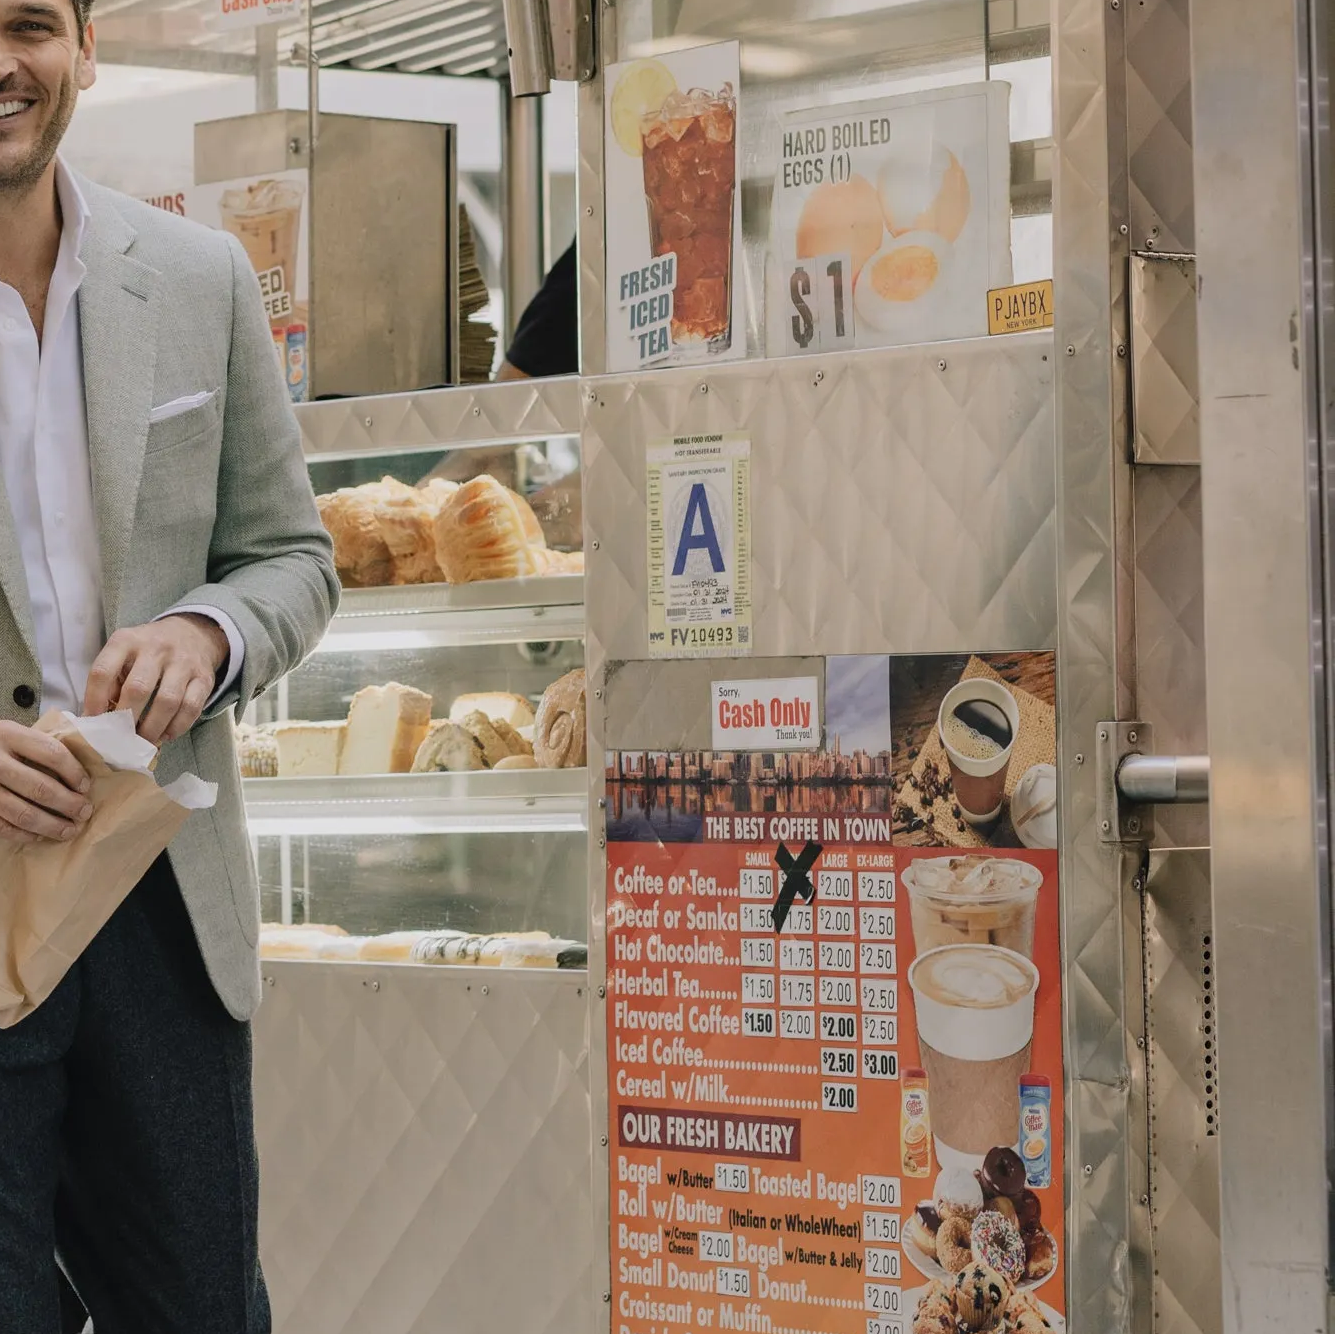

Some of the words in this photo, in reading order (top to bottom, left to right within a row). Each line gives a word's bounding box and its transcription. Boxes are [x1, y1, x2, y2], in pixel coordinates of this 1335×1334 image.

[783, 127, 826, 158] HARD
[832, 118, 891, 151] BOILED
[783, 158, 824, 188] EGGS
[830, 152, 851, 184] (1)
[620, 258, 673, 301] FRESH
[630, 293, 670, 331] ICED
[1007, 321, 1020, 329] NEW
[1022, 318, 1038, 327] YORK
[638, 326, 669, 360] TEA
[673, 436, 691, 446] MOBILE
[691, 435, 704, 444] FOOD
[704, 434, 723, 443] VENDOR
[671, 483, 726, 576] A
[650, 633, 664, 641] NYC
[718, 687, 740, 698] Sorry,
[719, 699, 765, 729] Cash
[770, 696, 811, 729] Only
[775, 729, 797, 740] Thank
[798, 728, 813, 741] you!
[706, 818, 730, 840] THE
[734, 817, 765, 840] BEST
[769, 818, 819, 841] COFFEE
[823, 818, 840, 841] IN
[844, 818, 891, 842] TOWN
[745, 852, 771, 866] SMALL
[822, 854, 848, 868] LARGE
[857, 854, 894, 868] EX-LARGE
[615, 867, 664, 895] Coffee
[668, 875, 686, 895] or
[743, 873, 772, 895] $1.50
[820, 874, 850, 898] $2.00
[862, 876, 893, 900] $2.50
[614, 900, 660, 929] Decaf
[664, 911, 682, 930] or
[687, 902, 738, 932] Sanka
[743, 907, 773, 929] $1.50
[819, 908, 851, 932] $2.00
[862, 911, 893, 936] $2.50
[615, 935, 641, 962] Hot
[743, 942, 773, 964] $1.50
[783, 946, 813, 968] $1.75
[821, 944, 851, 968] $2.00
[861, 945, 893, 970] $2.50
[615, 969, 668, 997] Herbal
[745, 977, 773, 999] $1.50
[782, 978, 813, 1003] $1.75
[822, 980, 852, 1003] $2.00
[863, 986, 895, 1010] $2.50
[615, 1002, 684, 1032] Flavored
[688, 1007, 740, 1036] Coffee
[745, 1012, 773, 1033] $1.50
[781, 1013, 811, 1035] $2.00
[823, 1016, 855, 1039] $2.00
[865, 1018, 895, 1041] $2.50
[616, 1036, 648, 1064] Iced
[823, 1051, 855, 1073] $2.50
[864, 1053, 897, 1076] $3.00
[616, 1069, 667, 1098] Cereal
[824, 1086, 855, 1108] $2.00
[622, 1112, 662, 1145] OUR
[666, 1115, 719, 1149] FRESH
[724, 1120, 795, 1155] BAKERY
[1025, 1114, 1042, 1126] Coffee
[618, 1155, 662, 1189] Bagel
[667, 1169, 714, 1190] w/Butter
[717, 1167, 747, 1189] $1.50
[752, 1167, 811, 1199] Toasted
[816, 1173, 863, 1210] Bagel
[864, 1179, 896, 1204] $2.00
[618, 1188, 647, 1218] Roll
[652, 1192, 724, 1225] w/Butter
[728, 1209, 767, 1231] (Italian
[770, 1219, 782, 1231] or
[665, 1226, 698, 1241] w/Cream
[866, 1215, 897, 1239] $1.50
[618, 1224, 663, 1259] Bagel
[668, 1241, 694, 1256] Cheese
[702, 1235, 730, 1258] $2.00
[737, 1235, 784, 1272] Bagel
[785, 1246, 826, 1266] w/Butter
[829, 1251, 837, 1267] &
[840, 1252, 863, 1273] Jelly
[619, 1257, 662, 1287] Small
[667, 1263, 714, 1293] Donut
[867, 1251, 898, 1276] $2.00
[719, 1269, 748, 1294] $1.50
[619, 1291, 692, 1324] Croissant
[697, 1306, 713, 1326] or
[867, 1285, 898, 1311] $2.00
